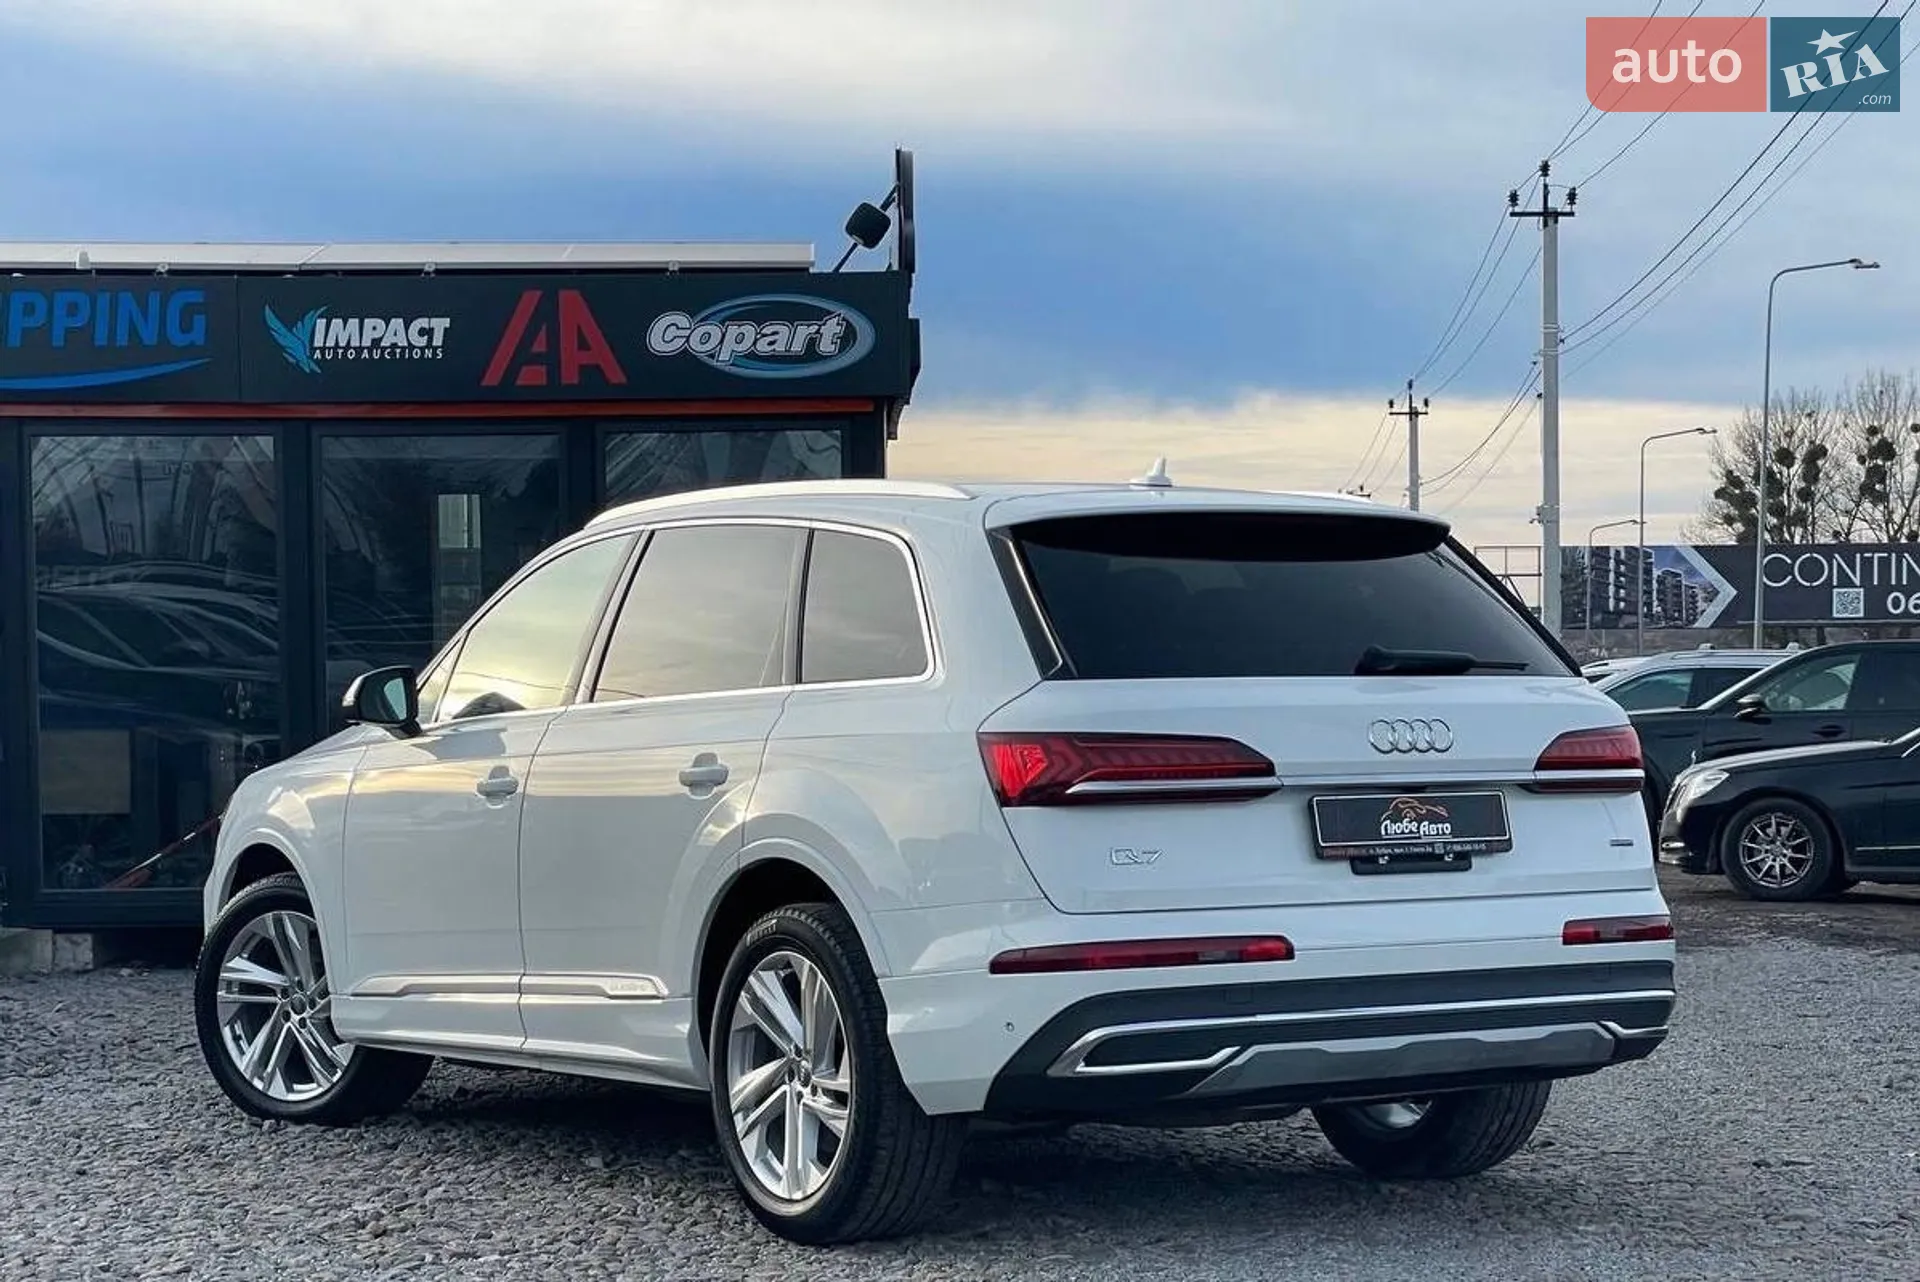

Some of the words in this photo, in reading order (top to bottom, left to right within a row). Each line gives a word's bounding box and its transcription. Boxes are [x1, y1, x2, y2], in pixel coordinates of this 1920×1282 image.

[313, 317, 450, 347] IMPACT
[647, 311, 847, 365] Copart
[313, 348, 356, 360] AUTO
[360, 347, 444, 359] AUCTIONS
[1762, 553, 1920, 587] CONTIN
[1381, 818, 1418, 835] Любе
[1110, 846, 1163, 866] Q7
